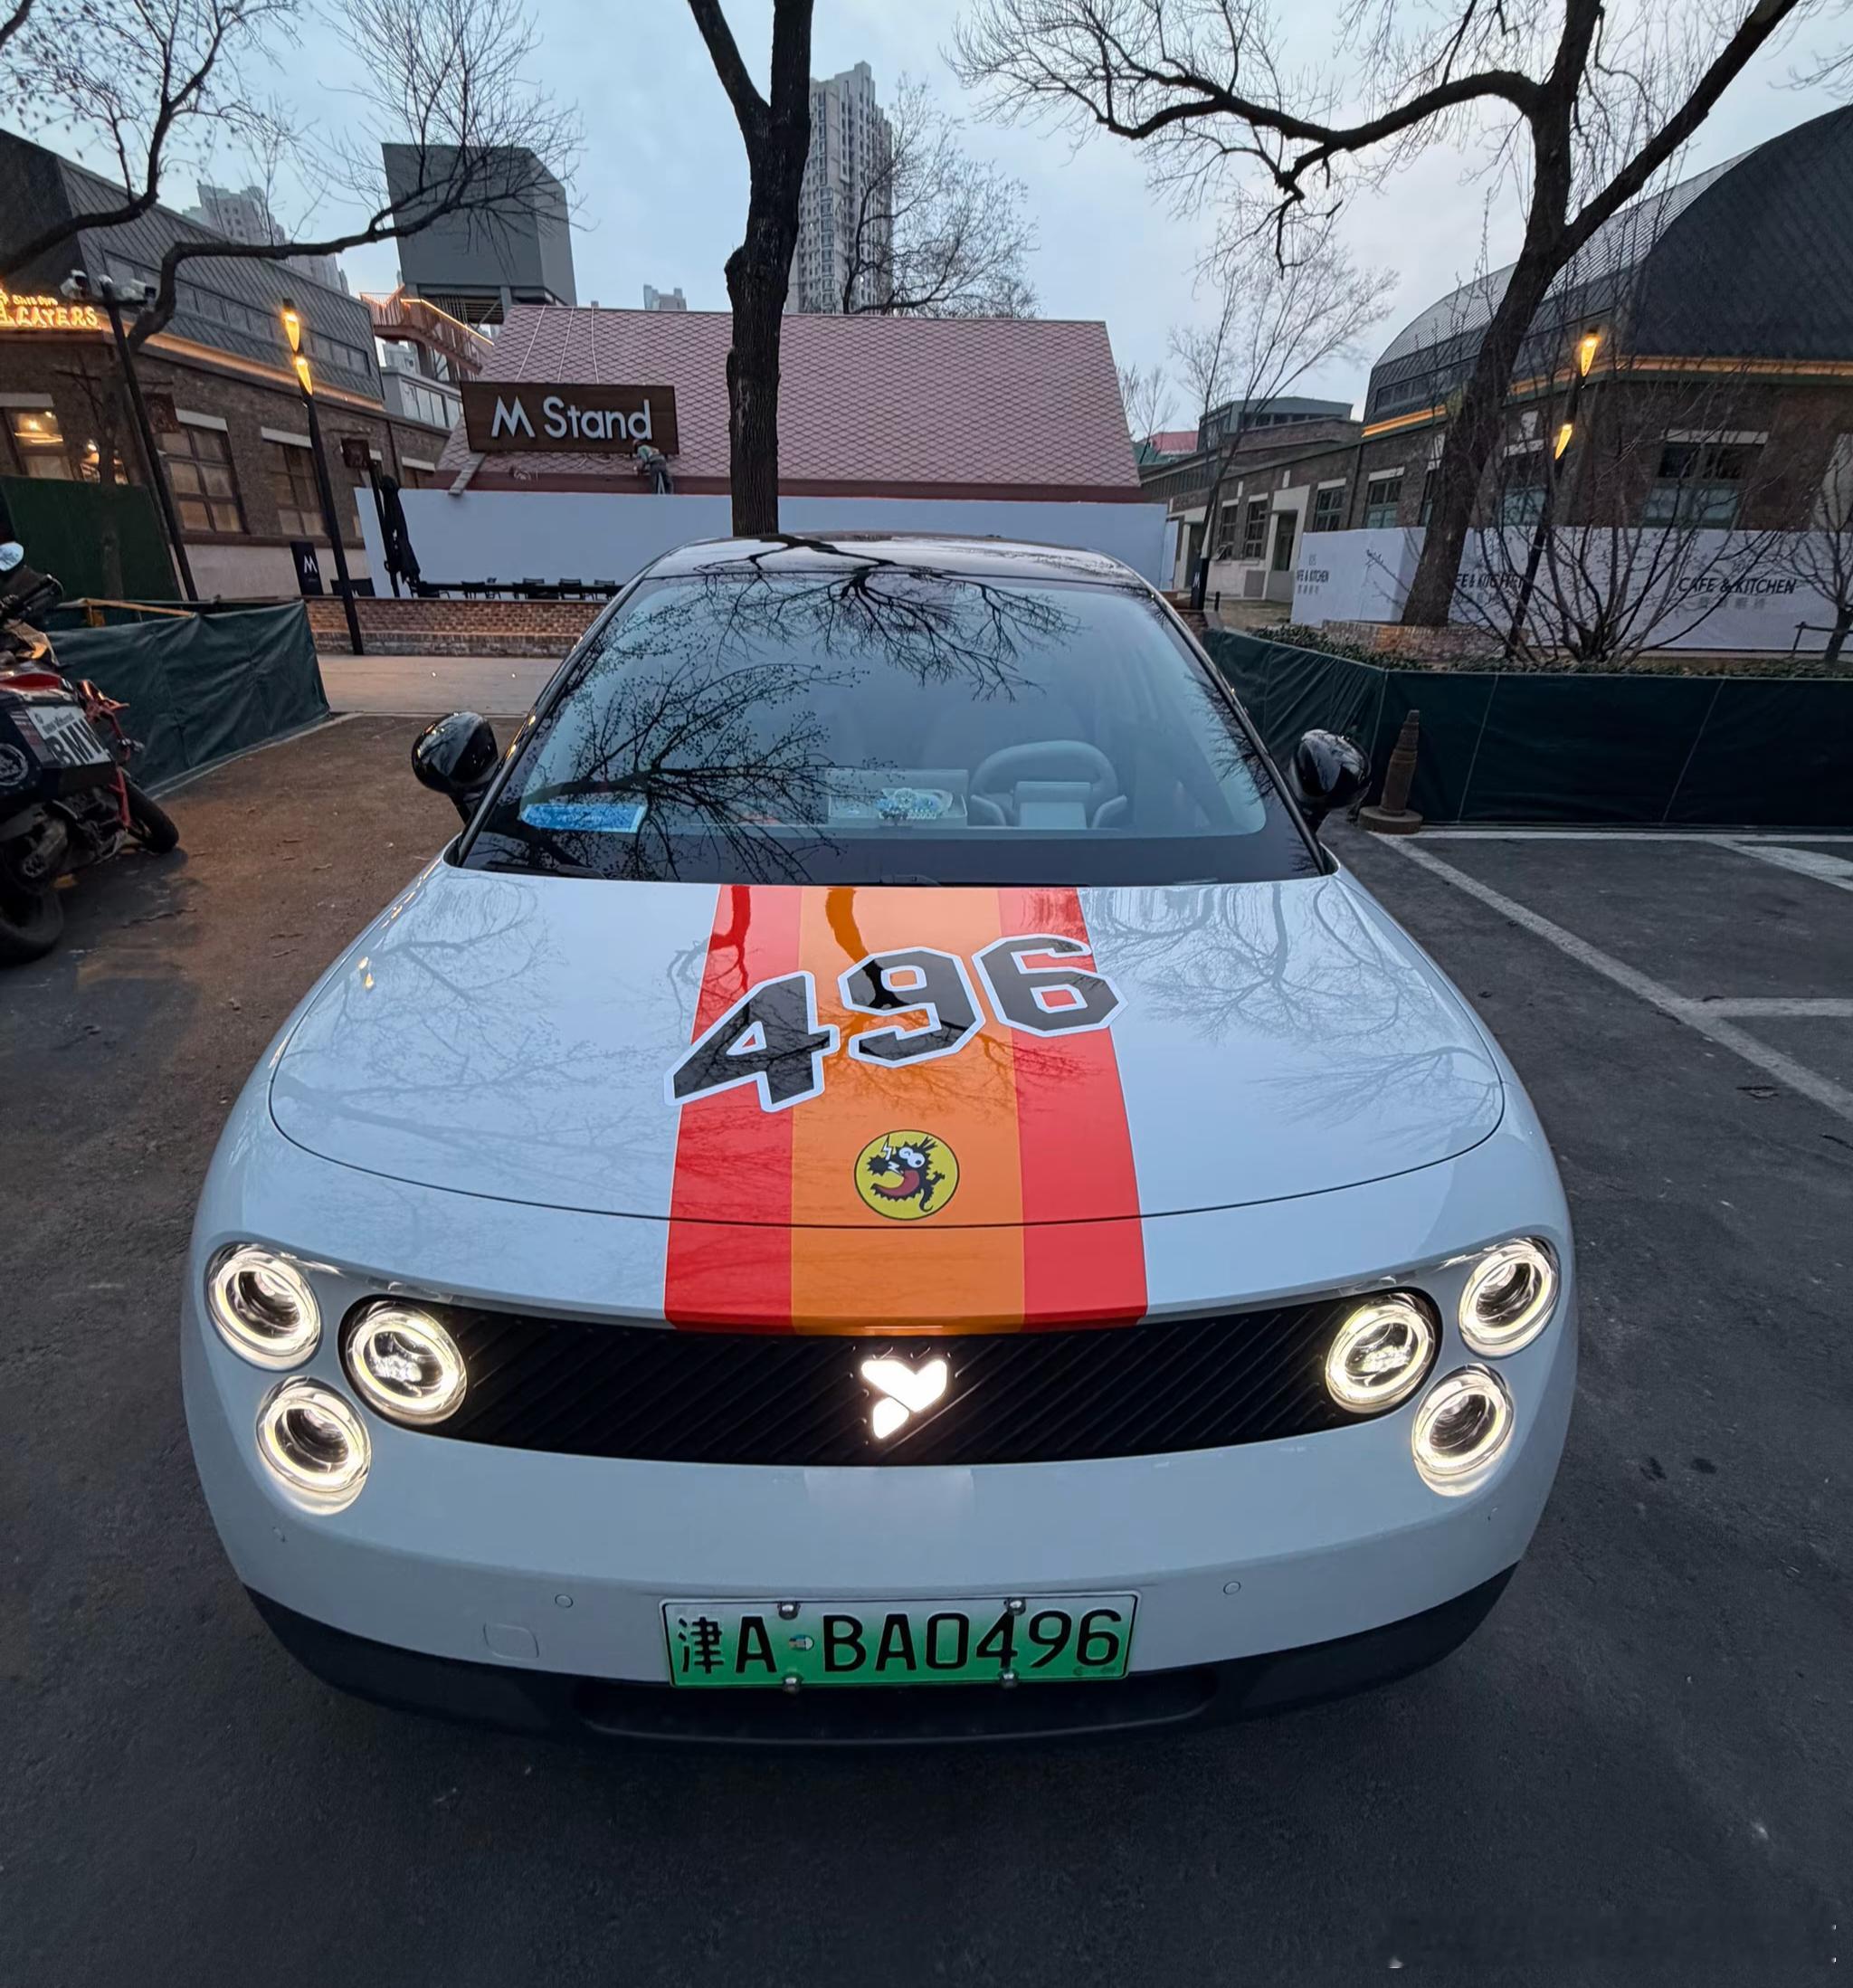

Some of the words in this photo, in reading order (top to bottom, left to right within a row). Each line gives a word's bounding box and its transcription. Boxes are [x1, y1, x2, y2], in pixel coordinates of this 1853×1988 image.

[491, 395, 536, 438] M
[543, 395, 652, 440] Stand
[1678, 577, 1716, 593] CAFE
[1719, 578, 1732, 593] &
[1734, 578, 1797, 594] KITCHEN
[664, 934, 1128, 1112] 496
[822, 1609, 1122, 1672] BA0496
